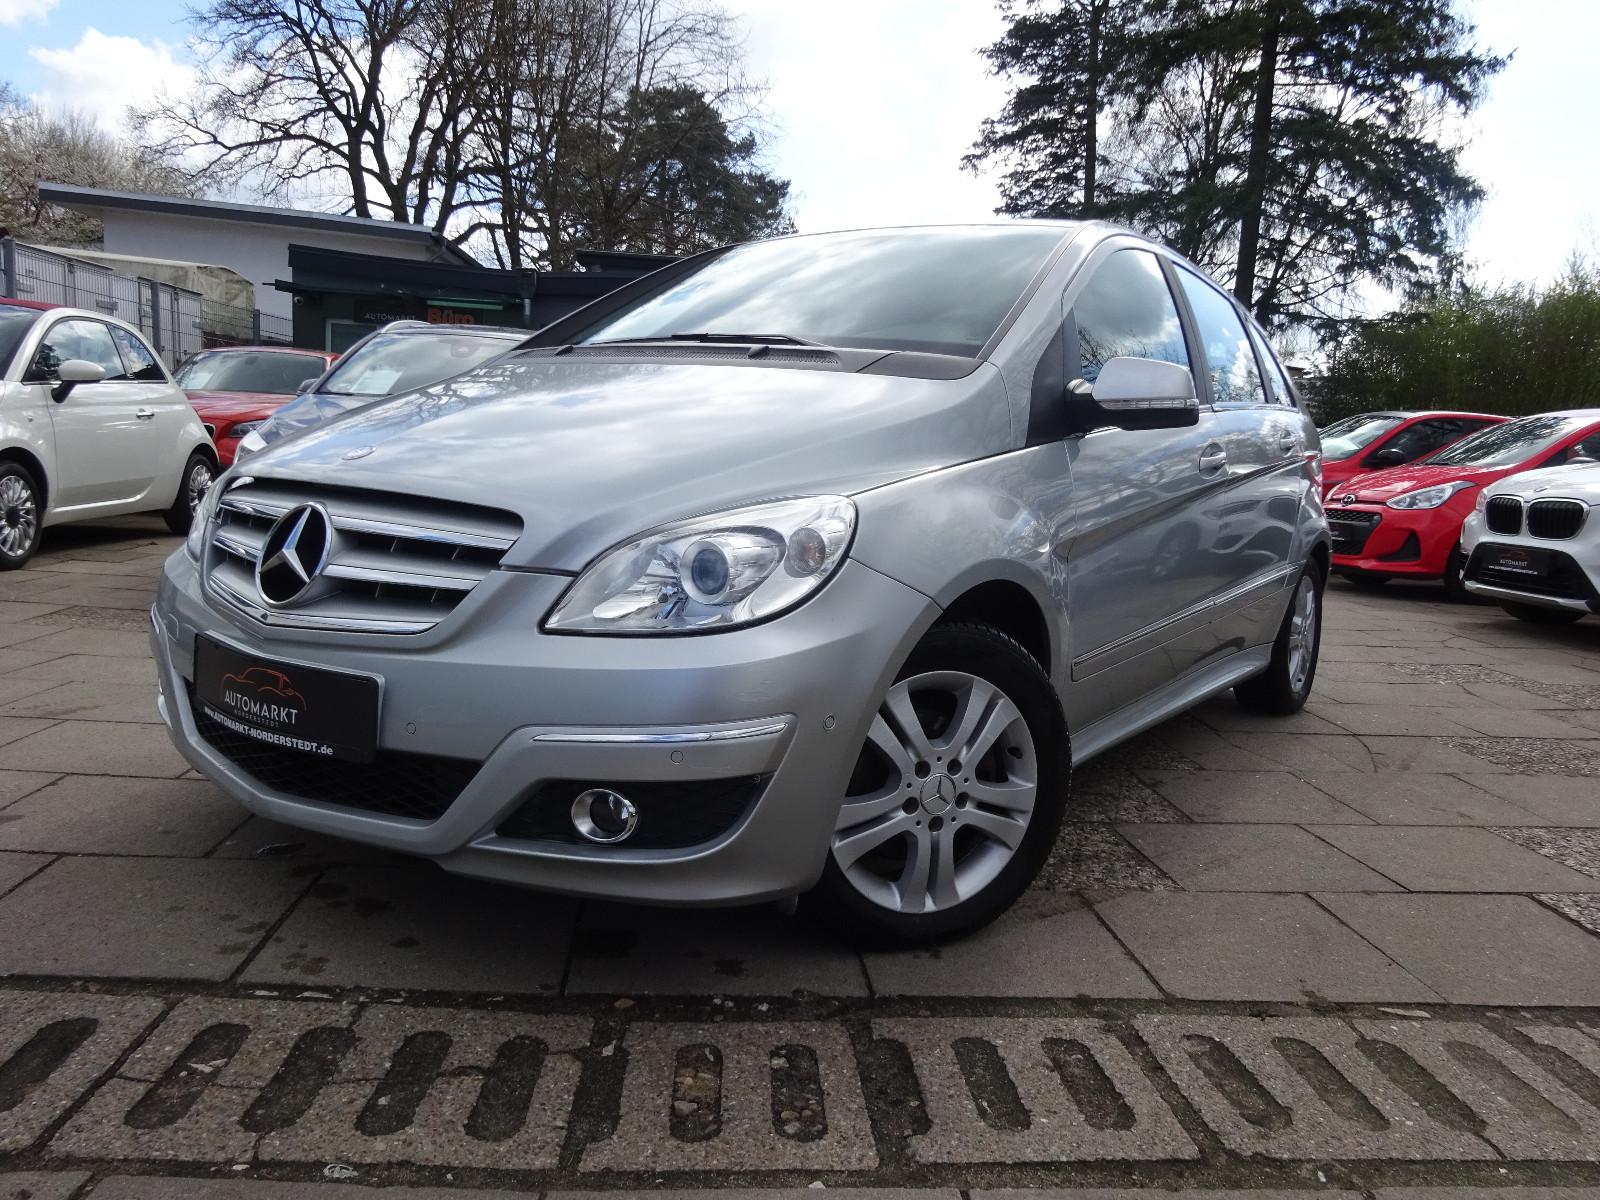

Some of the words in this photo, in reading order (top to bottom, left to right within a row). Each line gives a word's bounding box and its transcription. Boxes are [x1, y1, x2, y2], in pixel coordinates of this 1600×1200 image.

[427, 308, 475, 325] Büro
[224, 689, 299, 725] AUTOMARKT
[204, 705, 334, 756] www.AUTOMARKT-NORDERSTEDT.de
